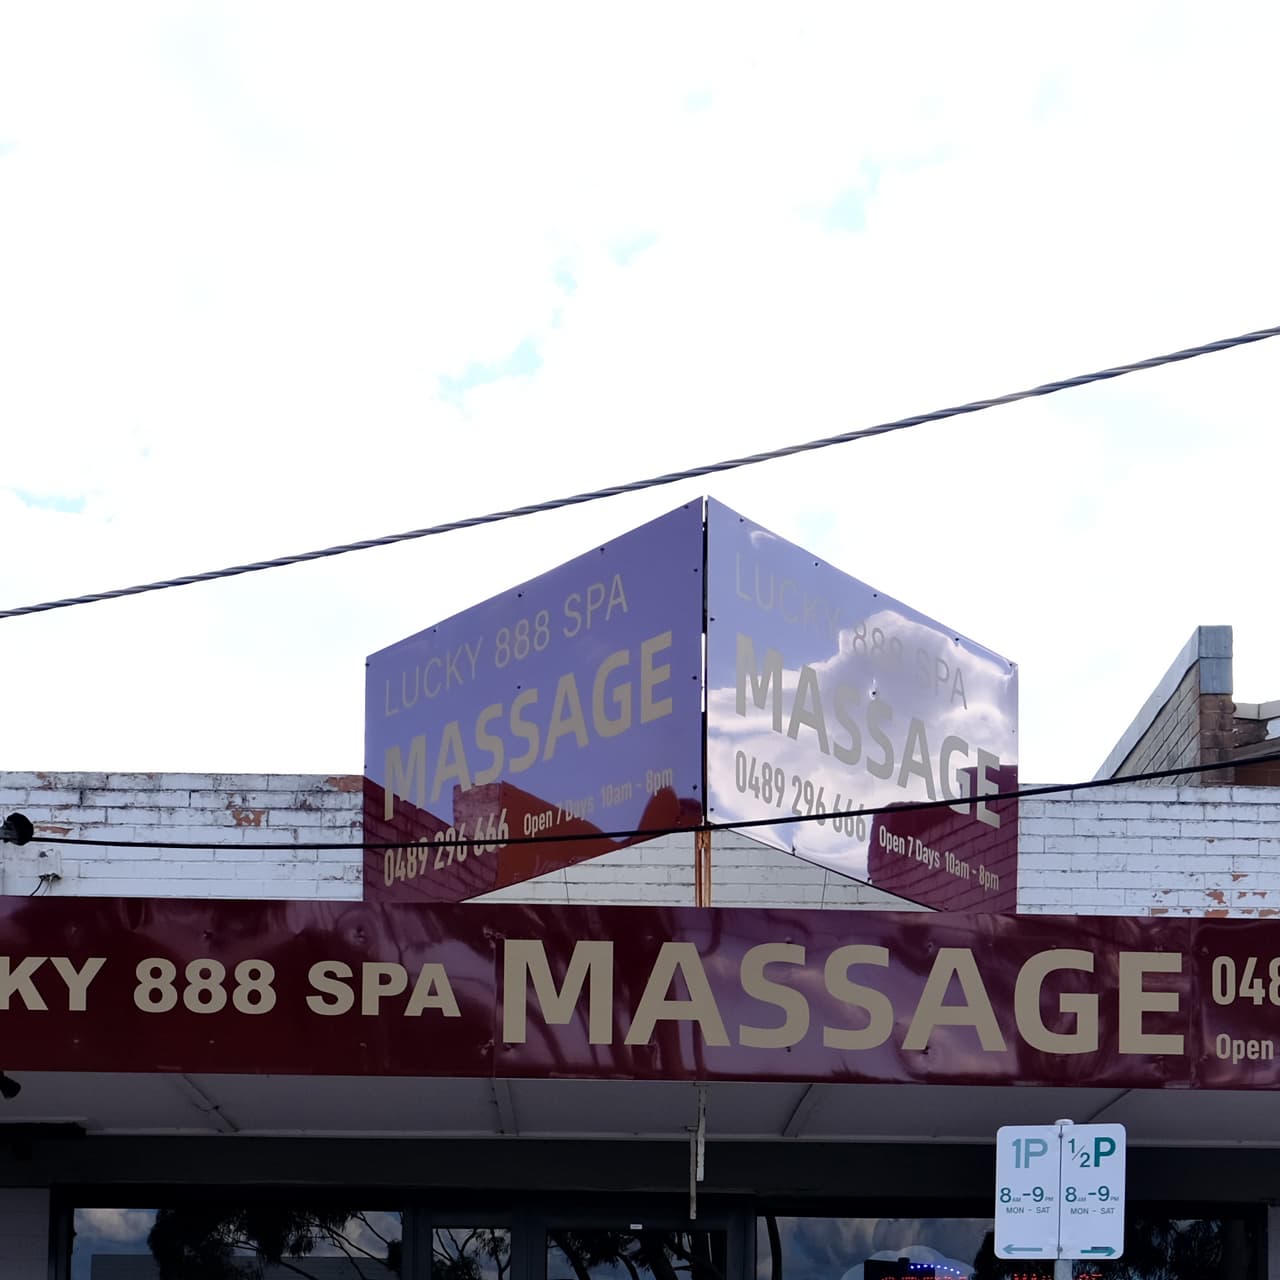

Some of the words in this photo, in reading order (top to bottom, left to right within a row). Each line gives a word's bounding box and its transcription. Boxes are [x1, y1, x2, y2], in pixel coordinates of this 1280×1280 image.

[385, 636, 483, 718] LUCKY
[495, 610, 550, 668] 888
[563, 573, 628, 638] SPA
[735, 550, 841, 633] LUCKY
[852, 623, 904, 665] 888
[918, 647, 967, 710] SPA
[384, 630, 673, 822] MASSAGE
[736, 631, 1001, 830] MASSAGE
[384, 837, 428, 888] 0489
[434, 824, 468, 871] 296
[474, 808, 509, 857] 666
[524, 810, 553, 837] Open
[566, 796, 594, 822] Days
[602, 782, 632, 807] 10am
[646, 767, 673, 797] 8pm
[736, 750, 785, 809] 0489
[791, 774, 826, 827] 296
[831, 794, 866, 842] 666
[879, 825, 906, 857] Open
[907, 836, 915, 856] 7
[916, 839, 940, 868] Days
[944, 853, 970, 881] 10am
[979, 863, 1000, 891] 8pm
[133, 957, 276, 1015] 888
[305, 960, 461, 1018] SPA
[502, 939, 1184, 1056] MASSAGE
[1215, 1033, 1273, 1066] Open
[1012, 1138, 1048, 1169] 1P
